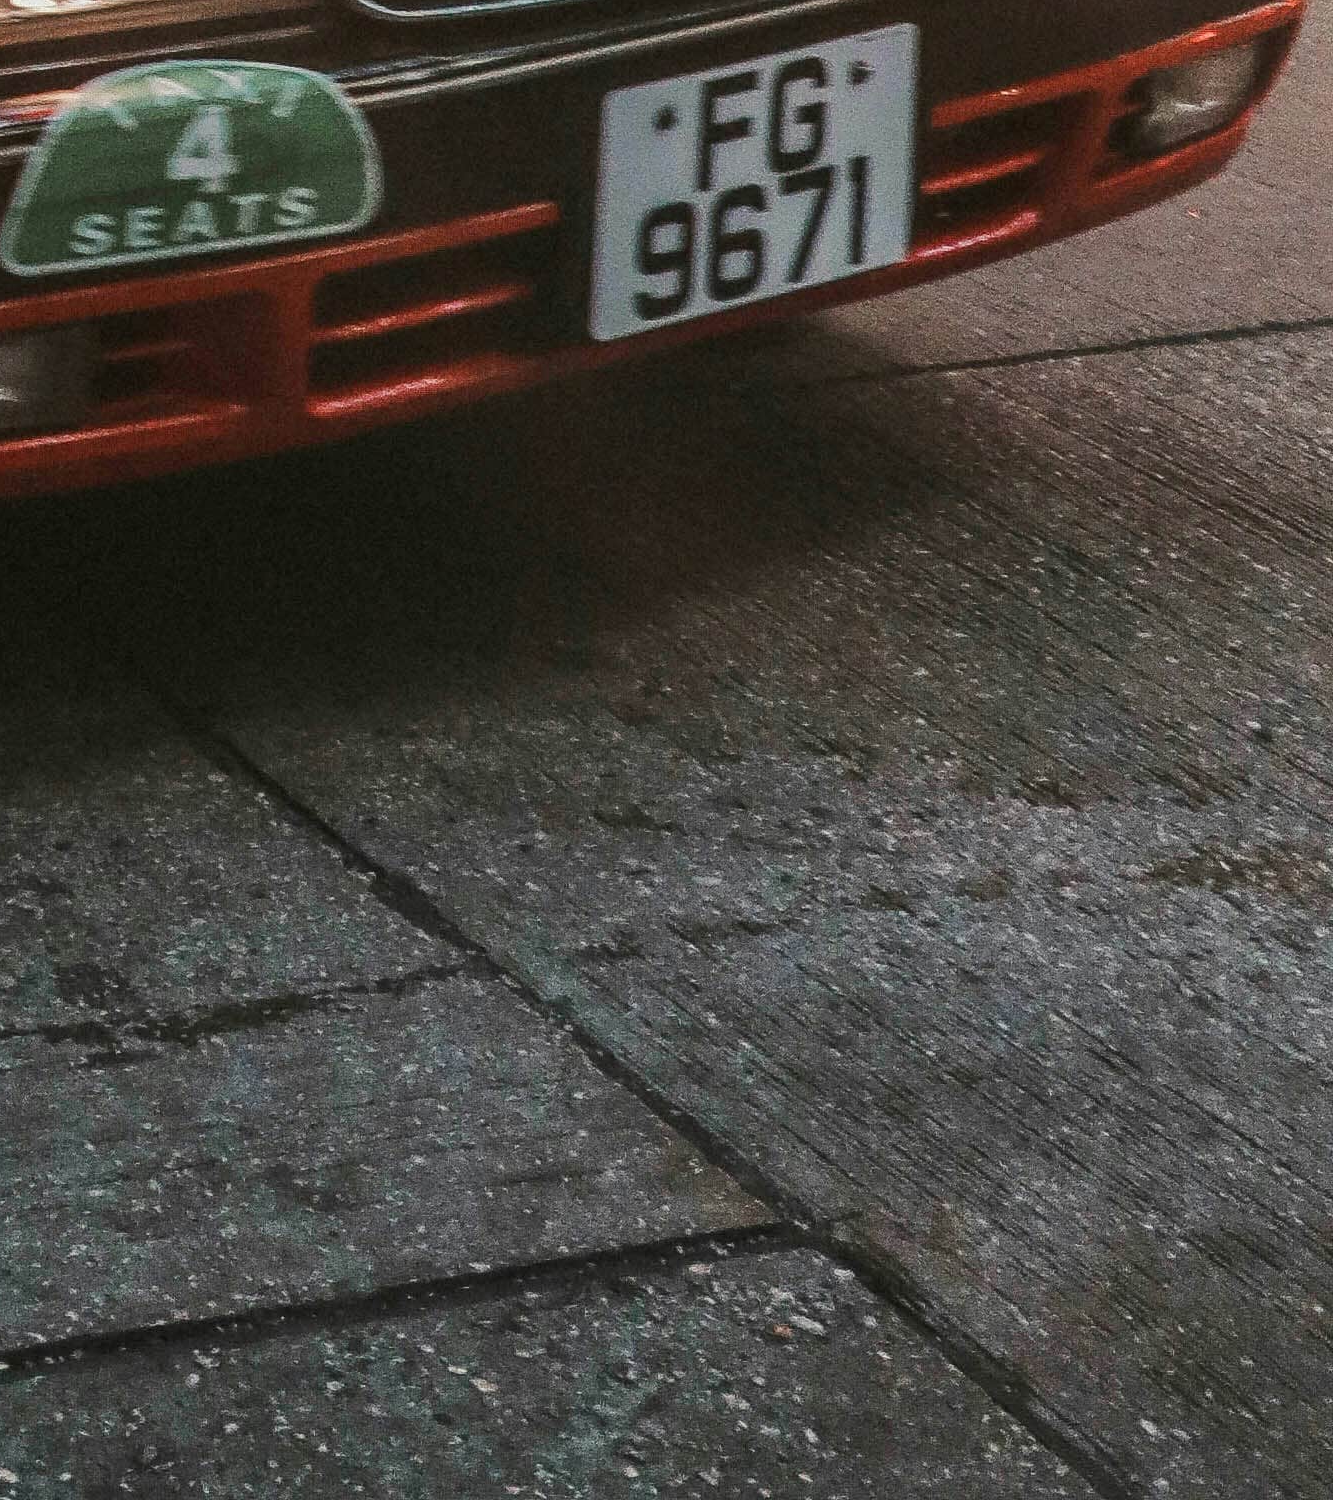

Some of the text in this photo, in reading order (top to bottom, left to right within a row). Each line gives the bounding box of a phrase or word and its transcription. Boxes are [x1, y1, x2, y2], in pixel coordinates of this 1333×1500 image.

[165, 103, 240, 195] 4
[699, 54, 828, 192] FG
[68, 185, 320, 257] SEATS
[633, 154, 871, 322] 9671
